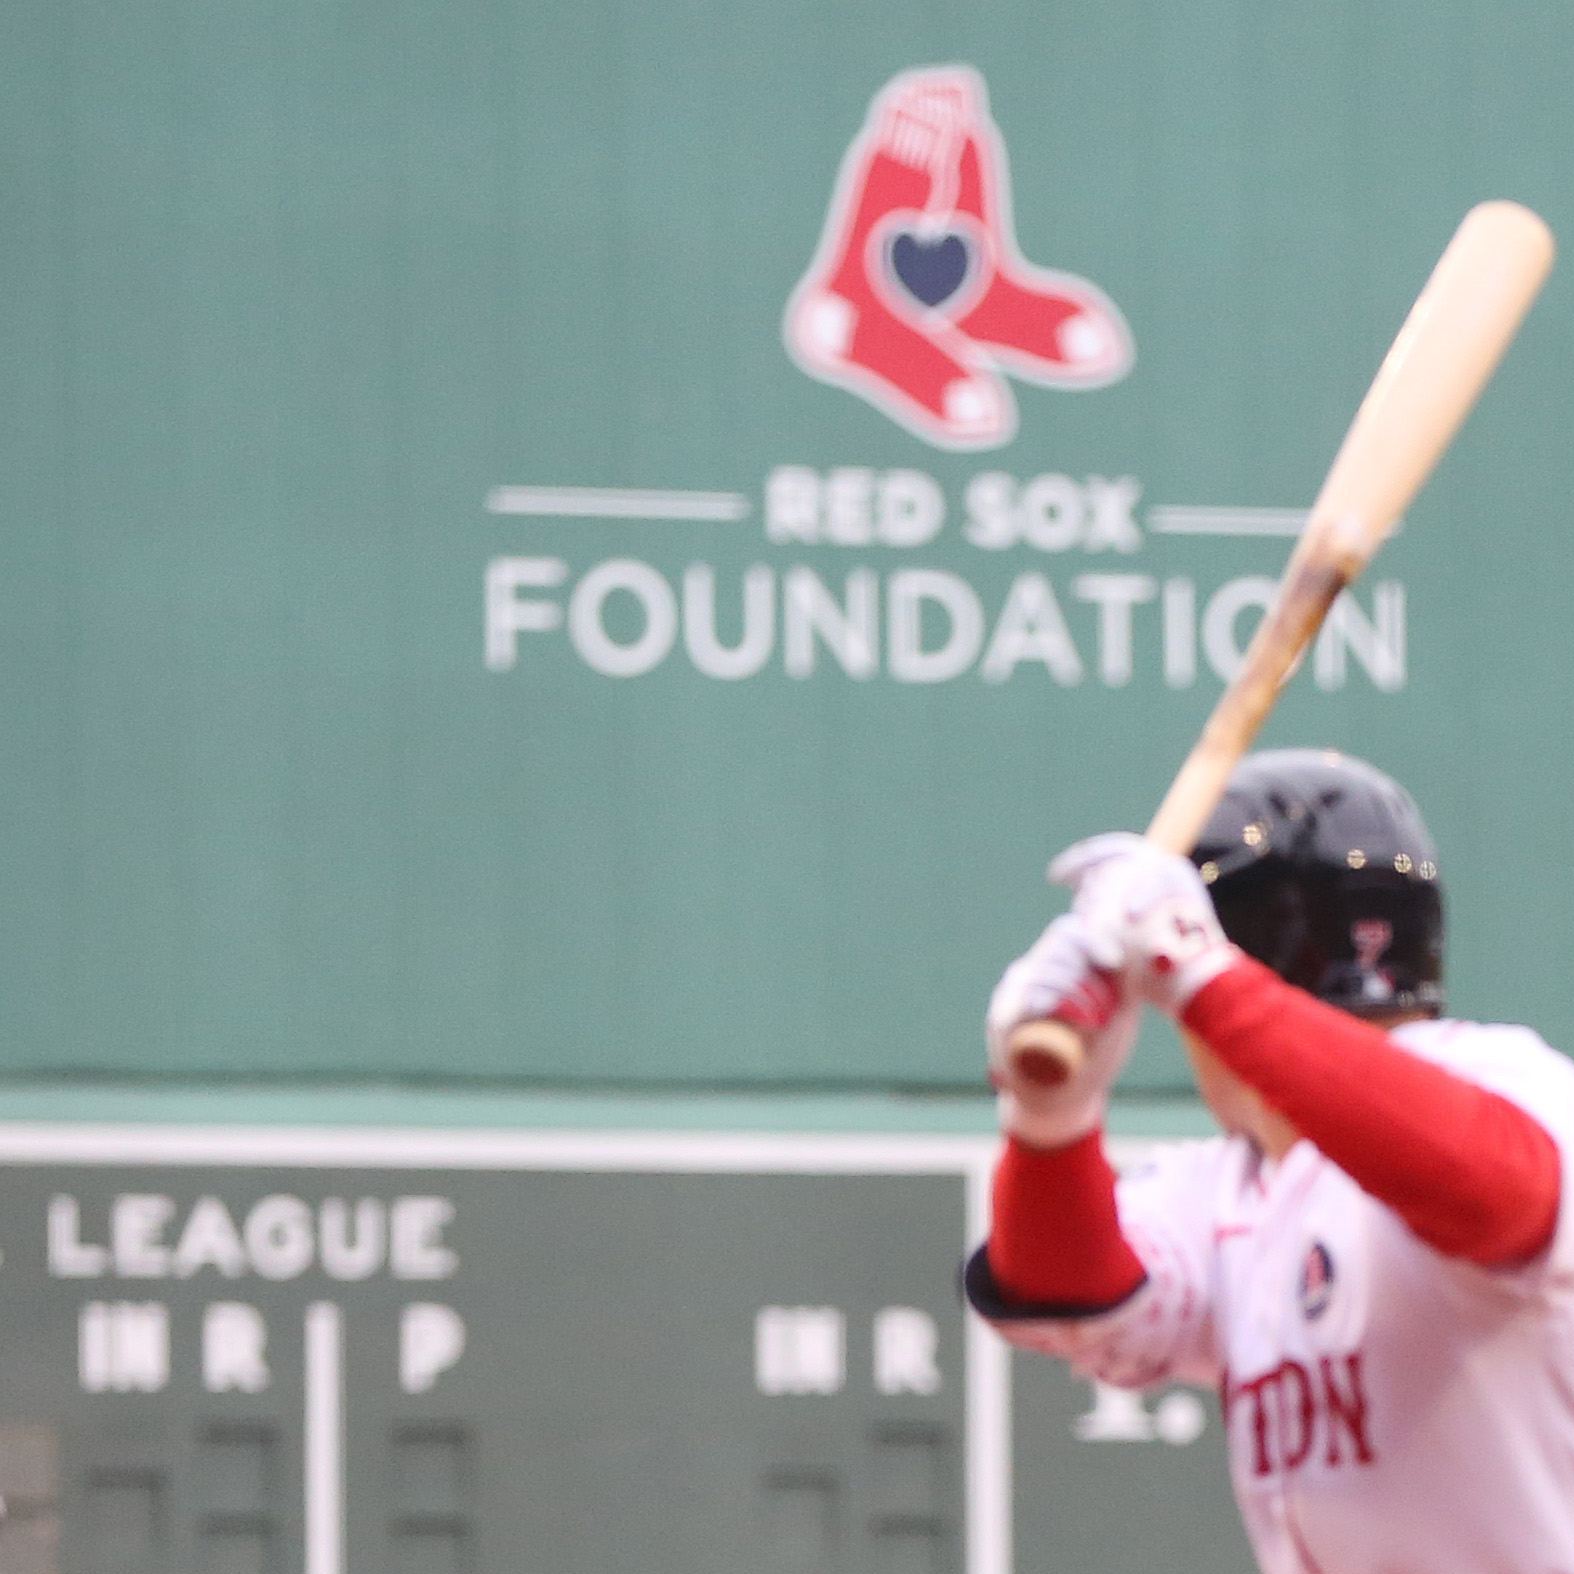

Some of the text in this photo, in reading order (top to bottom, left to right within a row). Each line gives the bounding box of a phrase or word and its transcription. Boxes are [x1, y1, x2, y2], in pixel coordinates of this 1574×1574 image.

[764, 465, 1142, 552] RED SOX
[483, 556, 1408, 692] FOUNDATION
[47, 1193, 456, 1281] LEAGUE
[203, 1302, 268, 1392] R
[400, 1302, 464, 1392] P
[873, 1307, 940, 1395] R
